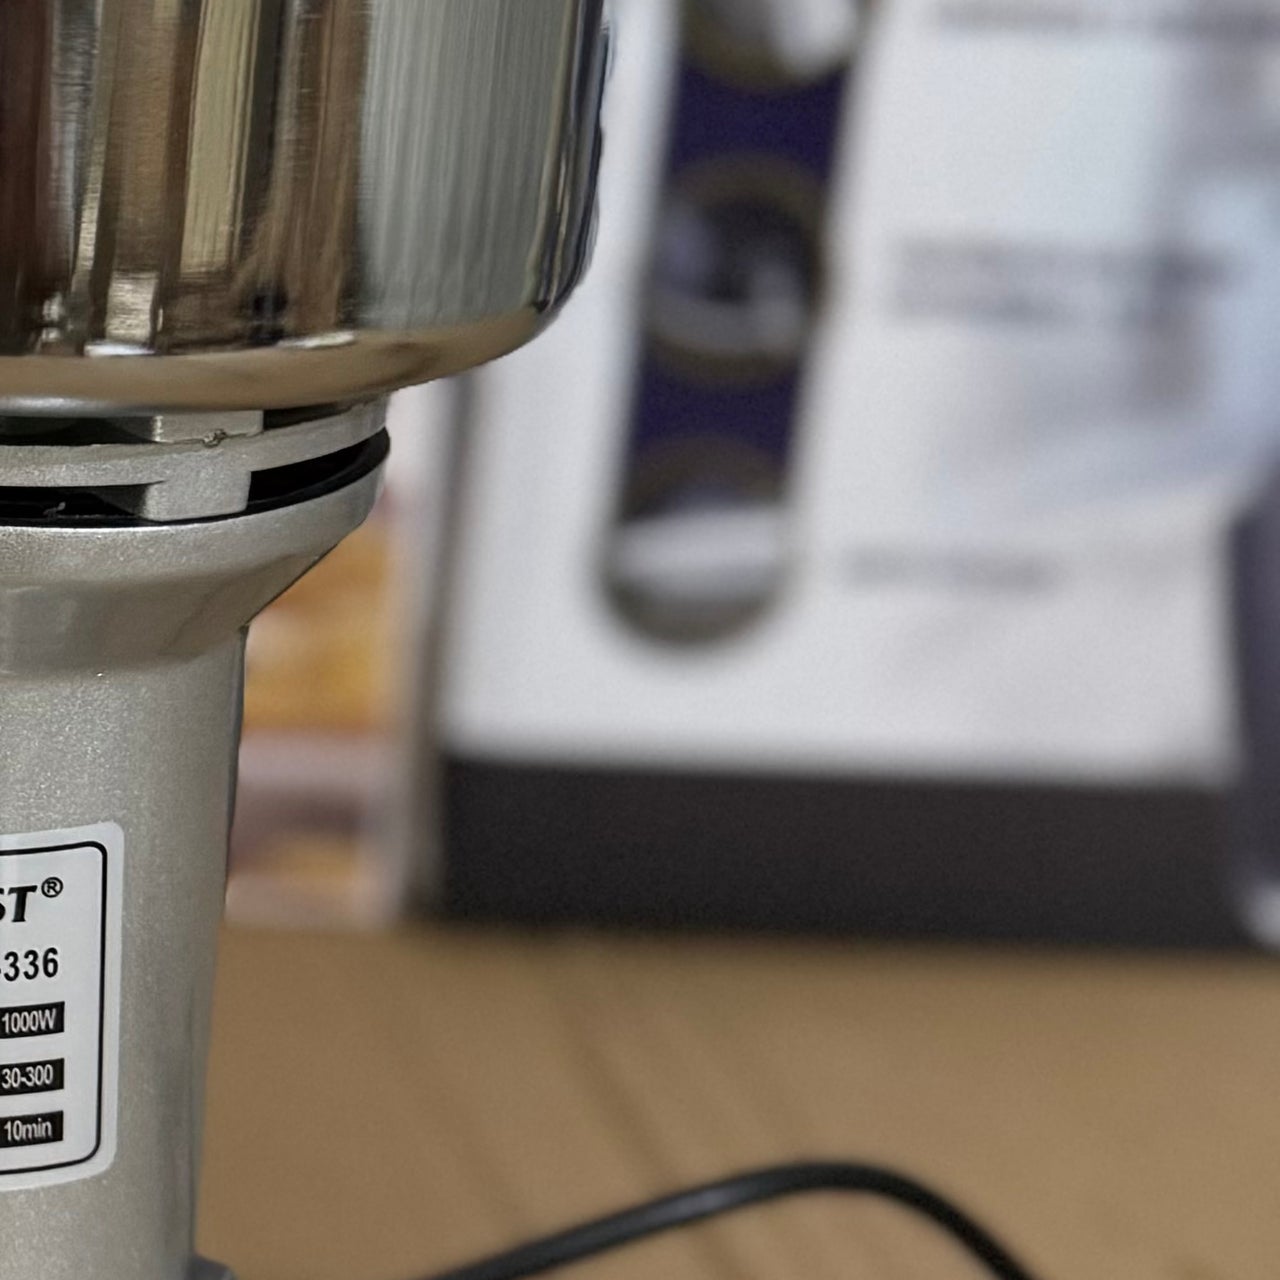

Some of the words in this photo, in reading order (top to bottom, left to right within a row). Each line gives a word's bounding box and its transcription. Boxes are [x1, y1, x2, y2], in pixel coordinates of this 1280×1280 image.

[1, 1007, 57, 1034] 1000W
[1, 1063, 53, 1089] 30-300
[3, 1118, 53, 1142] 10min
